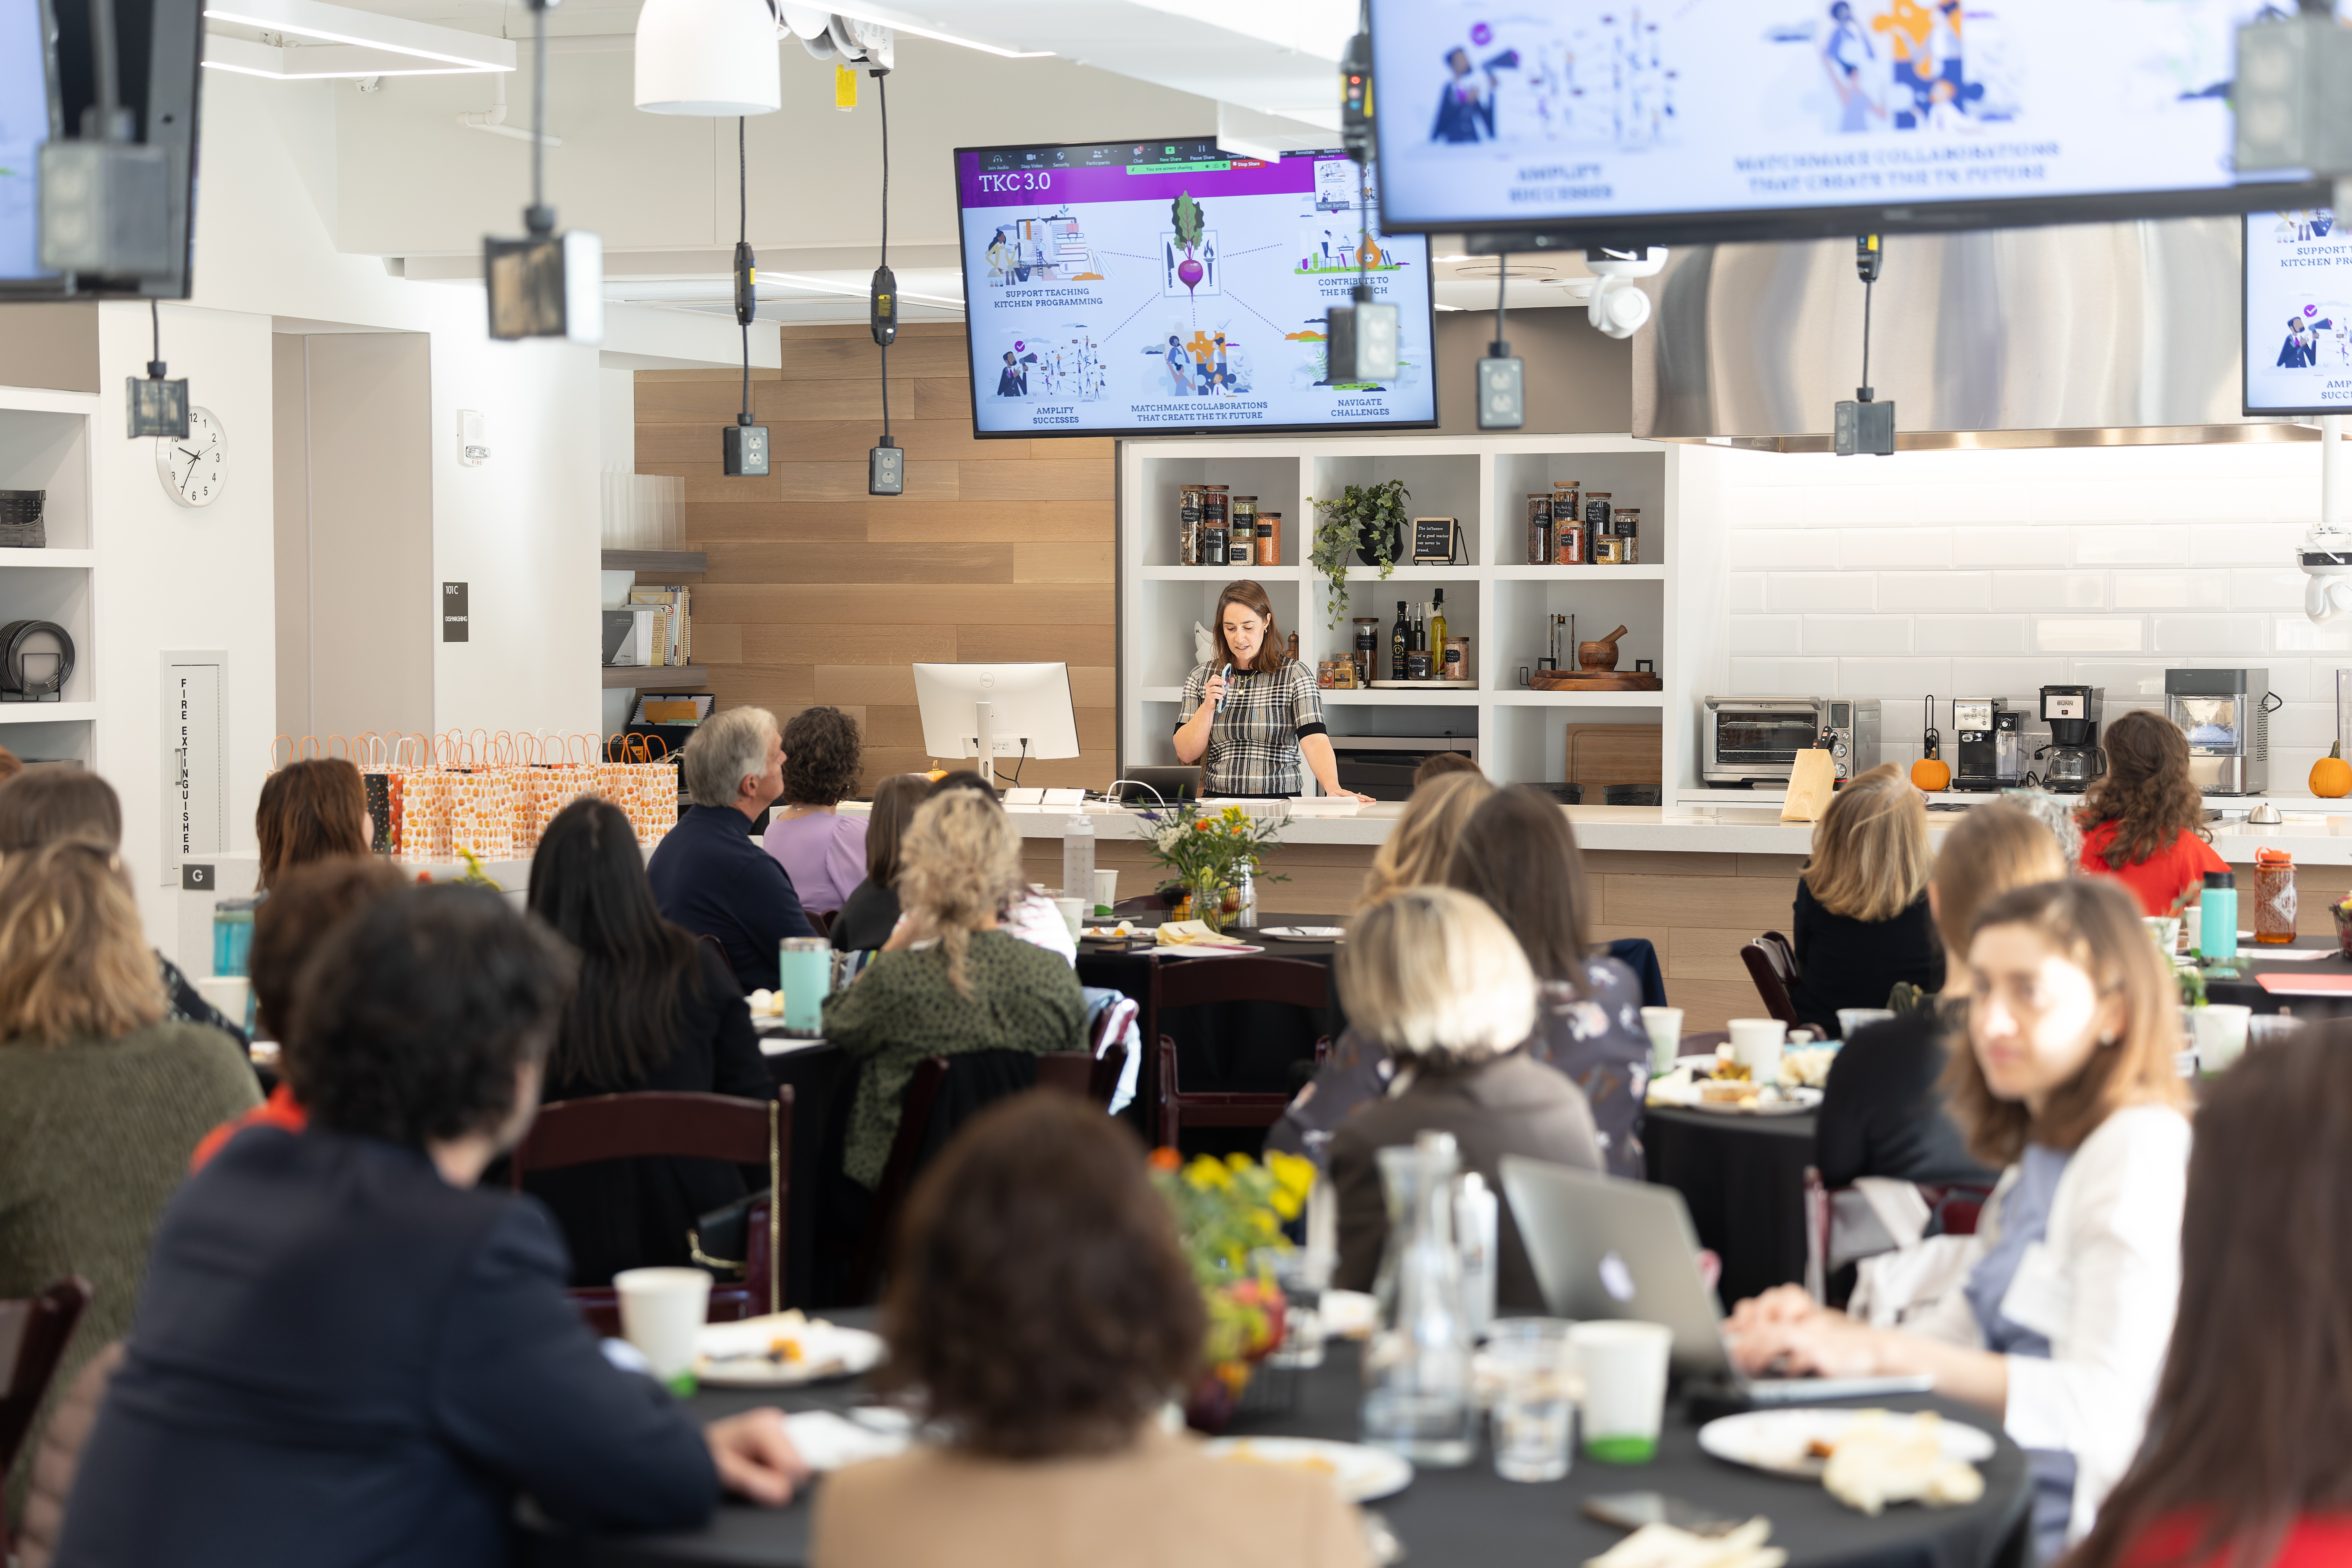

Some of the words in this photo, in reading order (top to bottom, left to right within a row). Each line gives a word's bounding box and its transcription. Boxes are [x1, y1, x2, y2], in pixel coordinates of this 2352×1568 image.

[979, 174, 1020, 192] TKC
[1024, 172, 1051, 190] 3.0
[2297, 246, 2345, 255] SUPPORT
[2281, 258, 2331, 267] KITCHEN
[1005, 289, 1043, 298] SUPPORT
[1044, 288, 1089, 297] TEACHING
[994, 299, 1033, 308] KITCHEN
[1035, 297, 1103, 307] PROGRAMMING
[1131, 404, 1189, 412] MATCHMAKE
[1191, 402, 1268, 410] COLLABORATIONS
[1338, 398, 1382, 407] NAVIGATE
[1331, 408, 1390, 417] CHALLENGES
[189, 413, 198, 423] 12
[1033, 416, 1079, 424] SUCCESSES
[203, 419, 207, 428] 1
[212, 433, 216, 442] 2
[216, 453, 220, 463] 3
[212, 473, 216, 482] 4
[204, 486, 208, 495] 5
[192, 491, 196, 501] 6
[192, 869, 203, 882] G
